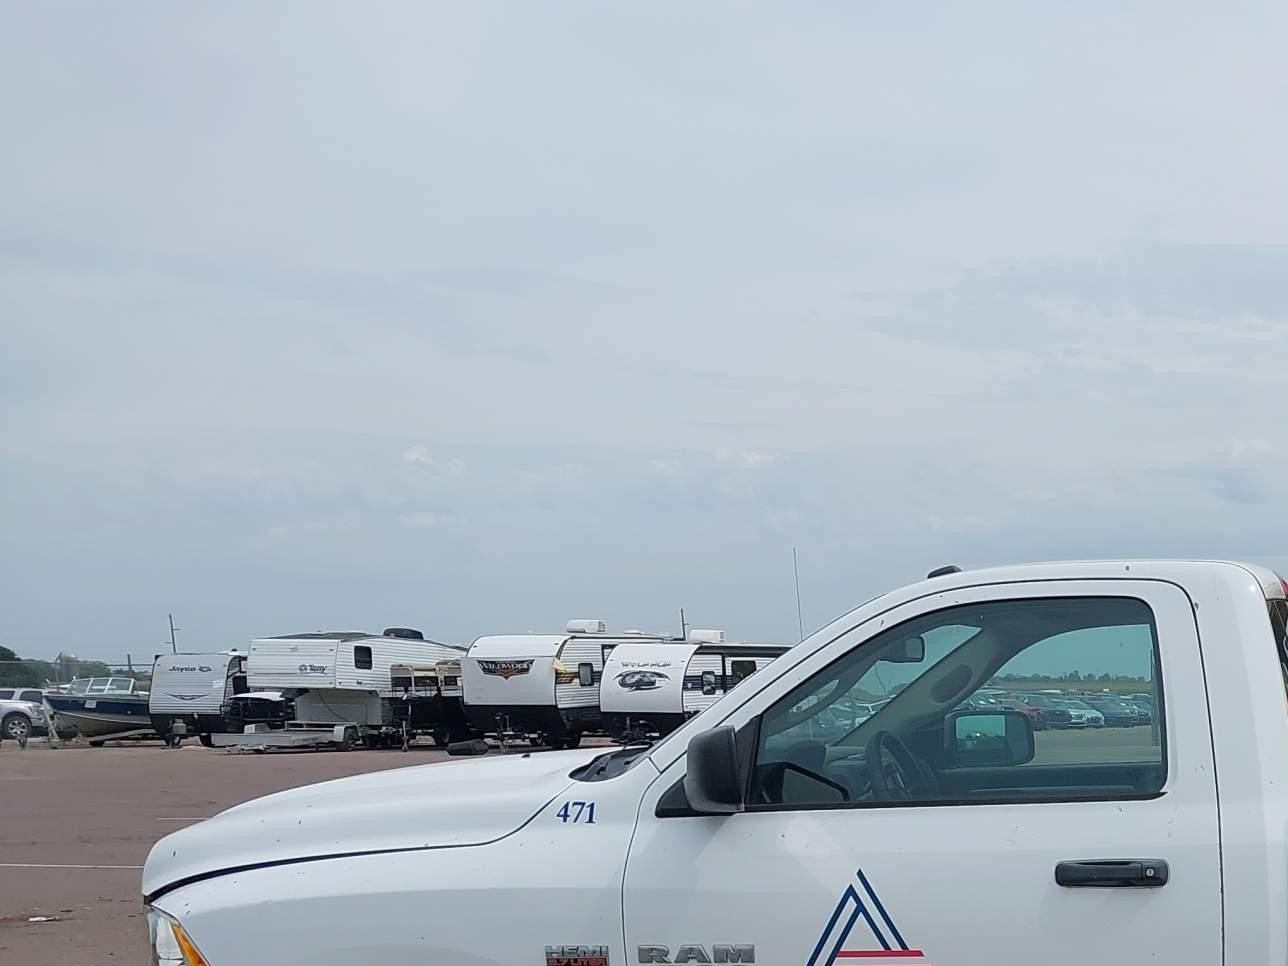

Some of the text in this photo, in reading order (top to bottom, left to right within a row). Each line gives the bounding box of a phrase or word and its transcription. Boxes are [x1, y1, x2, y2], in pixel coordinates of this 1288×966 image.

[556, 800, 597, 824] 471
[545, 945, 609, 957] HEMI
[638, 944, 755, 963] RAM
